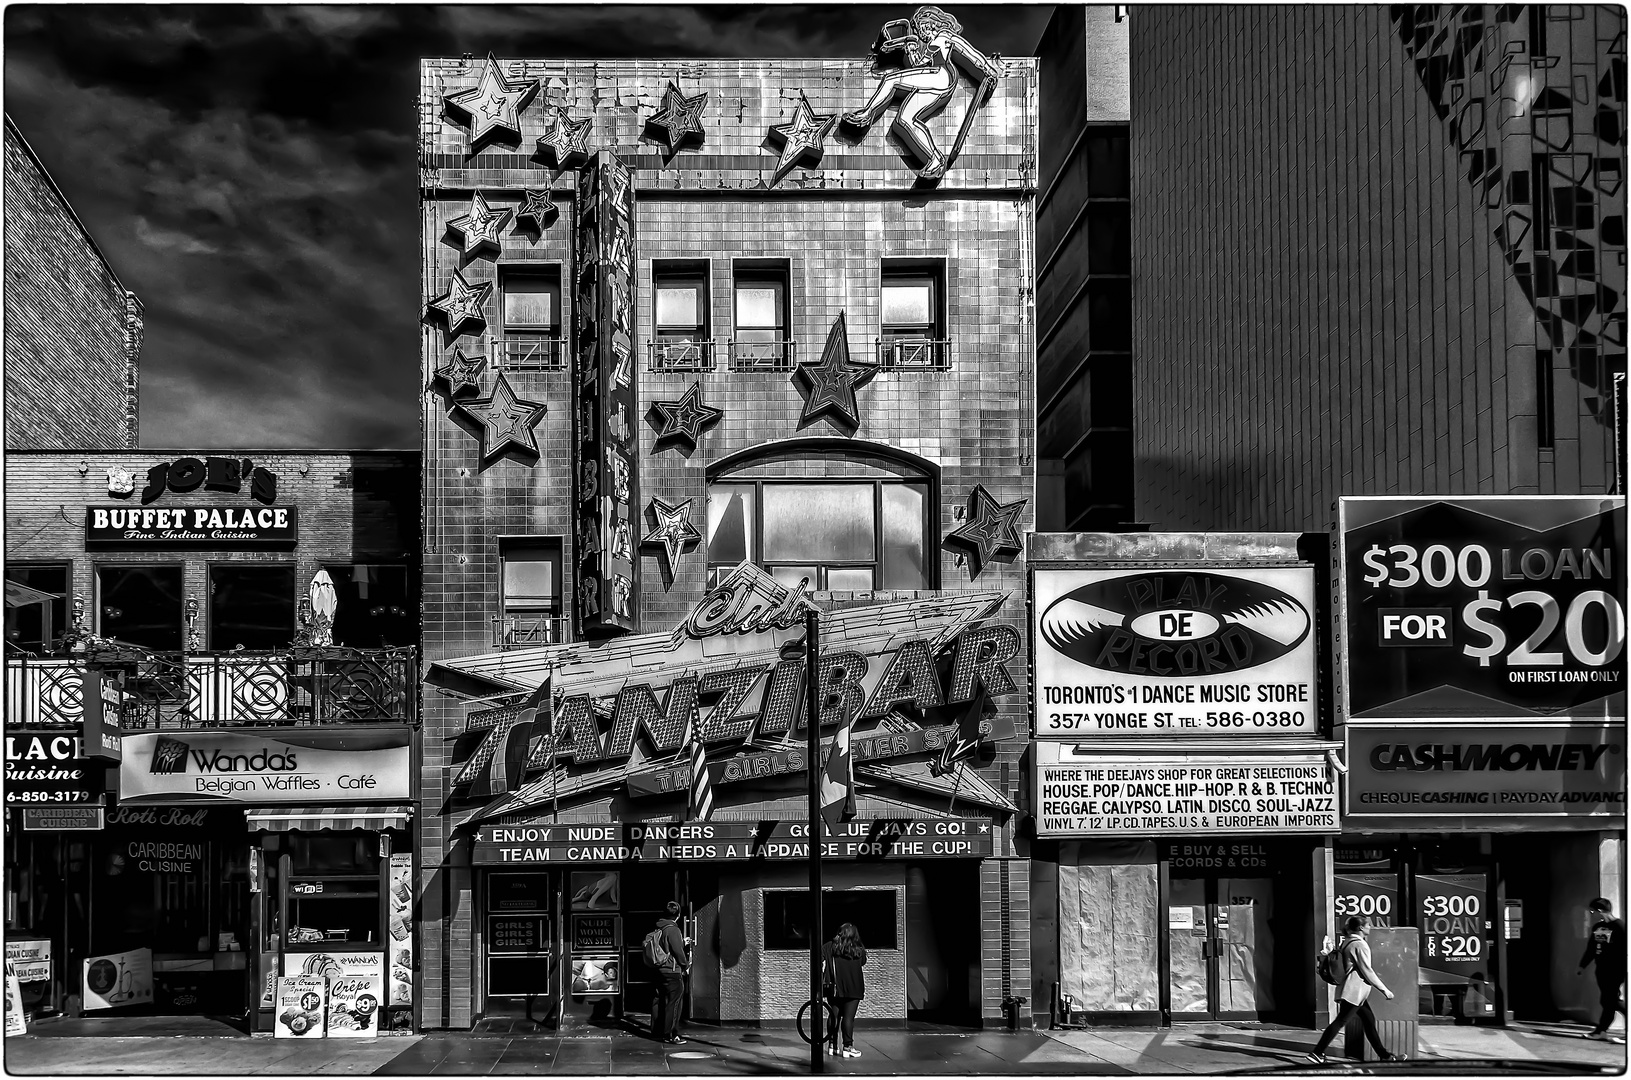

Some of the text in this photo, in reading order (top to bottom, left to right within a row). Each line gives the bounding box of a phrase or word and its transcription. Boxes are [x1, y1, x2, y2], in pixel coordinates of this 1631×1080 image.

[141, 457, 277, 505] JOE'S
[93, 508, 289, 529] BUFFET PALACE
[123, 529, 258, 540] Fine Indian Cuisine
[1362, 543, 1612, 588] $300 LOAN
[1125, 575, 1229, 613] PLAY
[1159, 612, 1193, 638] DE
[1383, 589, 1625, 667] FOR $20
[1094, 625, 1254, 676] RECORD
[1508, 670, 1620, 683] ON FIRST LOAN ONLY
[1043, 683, 1125, 704] TORONTO'S
[1142, 685, 1195, 704] DANCE
[1200, 684, 1251, 703] MUSIC
[1257, 683, 1308, 702] STORE
[1049, 711, 1305, 729] 357A YONGE ST. TEL: 586-0380
[189, 746, 298, 774] Wanda's
[655, 769, 690, 791] TH
[724, 751, 804, 782] GIRLS
[1044, 767, 1333, 782] WHERE THE DEEJAYS SHOP FOR GREAT SELECTIONS IN
[195, 774, 377, 794] Belgian Waffles Café
[1238, 782, 1248, 796] R
[1251, 782, 1263, 795] &
[6, 791, 90, 802] 6-850-3179
[27, 808, 97, 818] CARIBBEAN
[106, 806, 209, 826] Roti Roll
[1043, 817, 1075, 830] VINYL
[1201, 815, 1210, 827] &
[1216, 815, 1279, 827] EUROPEAN
[1284, 814, 1334, 827] IMPORTS
[39, 818, 88, 828] CUISINE
[492, 828, 552, 843] ENJOY
[568, 827, 615, 841] NUDE
[630, 826, 715, 840] DANCERS
[880, 822, 928, 836] JAYS
[934, 822, 966, 835] GO!
[128, 841, 202, 860] CARIBBEAN
[499, 847, 551, 861] TEAM
[566, 846, 643, 860] CANADA
[658, 845, 717, 859] NEEDS
[725, 844, 737, 857] A
[846, 842, 883, 856] FOR
[890, 841, 924, 855] THE
[931, 841, 972, 854] CUP!
[1183, 845, 1213, 855] BUY
[1216, 845, 1227, 855] &
[1231, 844, 1268, 855] SELL
[1227, 857, 1237, 867] &
[1240, 857, 1267, 867] CDs
[1335, 894, 1391, 915] $300
[1423, 895, 1480, 916] $300
[495, 921, 534, 929] GIRLS
[579, 928, 612, 936] WOMEN
[580, 919, 611, 927] NUDE
[1423, 917, 1480, 935] LOAN
[495, 930, 534, 938] GIRLS
[495, 938, 534, 946] GIRLS
[578, 937, 613, 945] NON STOP
[1441, 935, 1481, 957] $20
[283, 978, 322, 986] Ice Cream
[289, 986, 315, 994] Special
[331, 979, 371, 997] Crêpe
